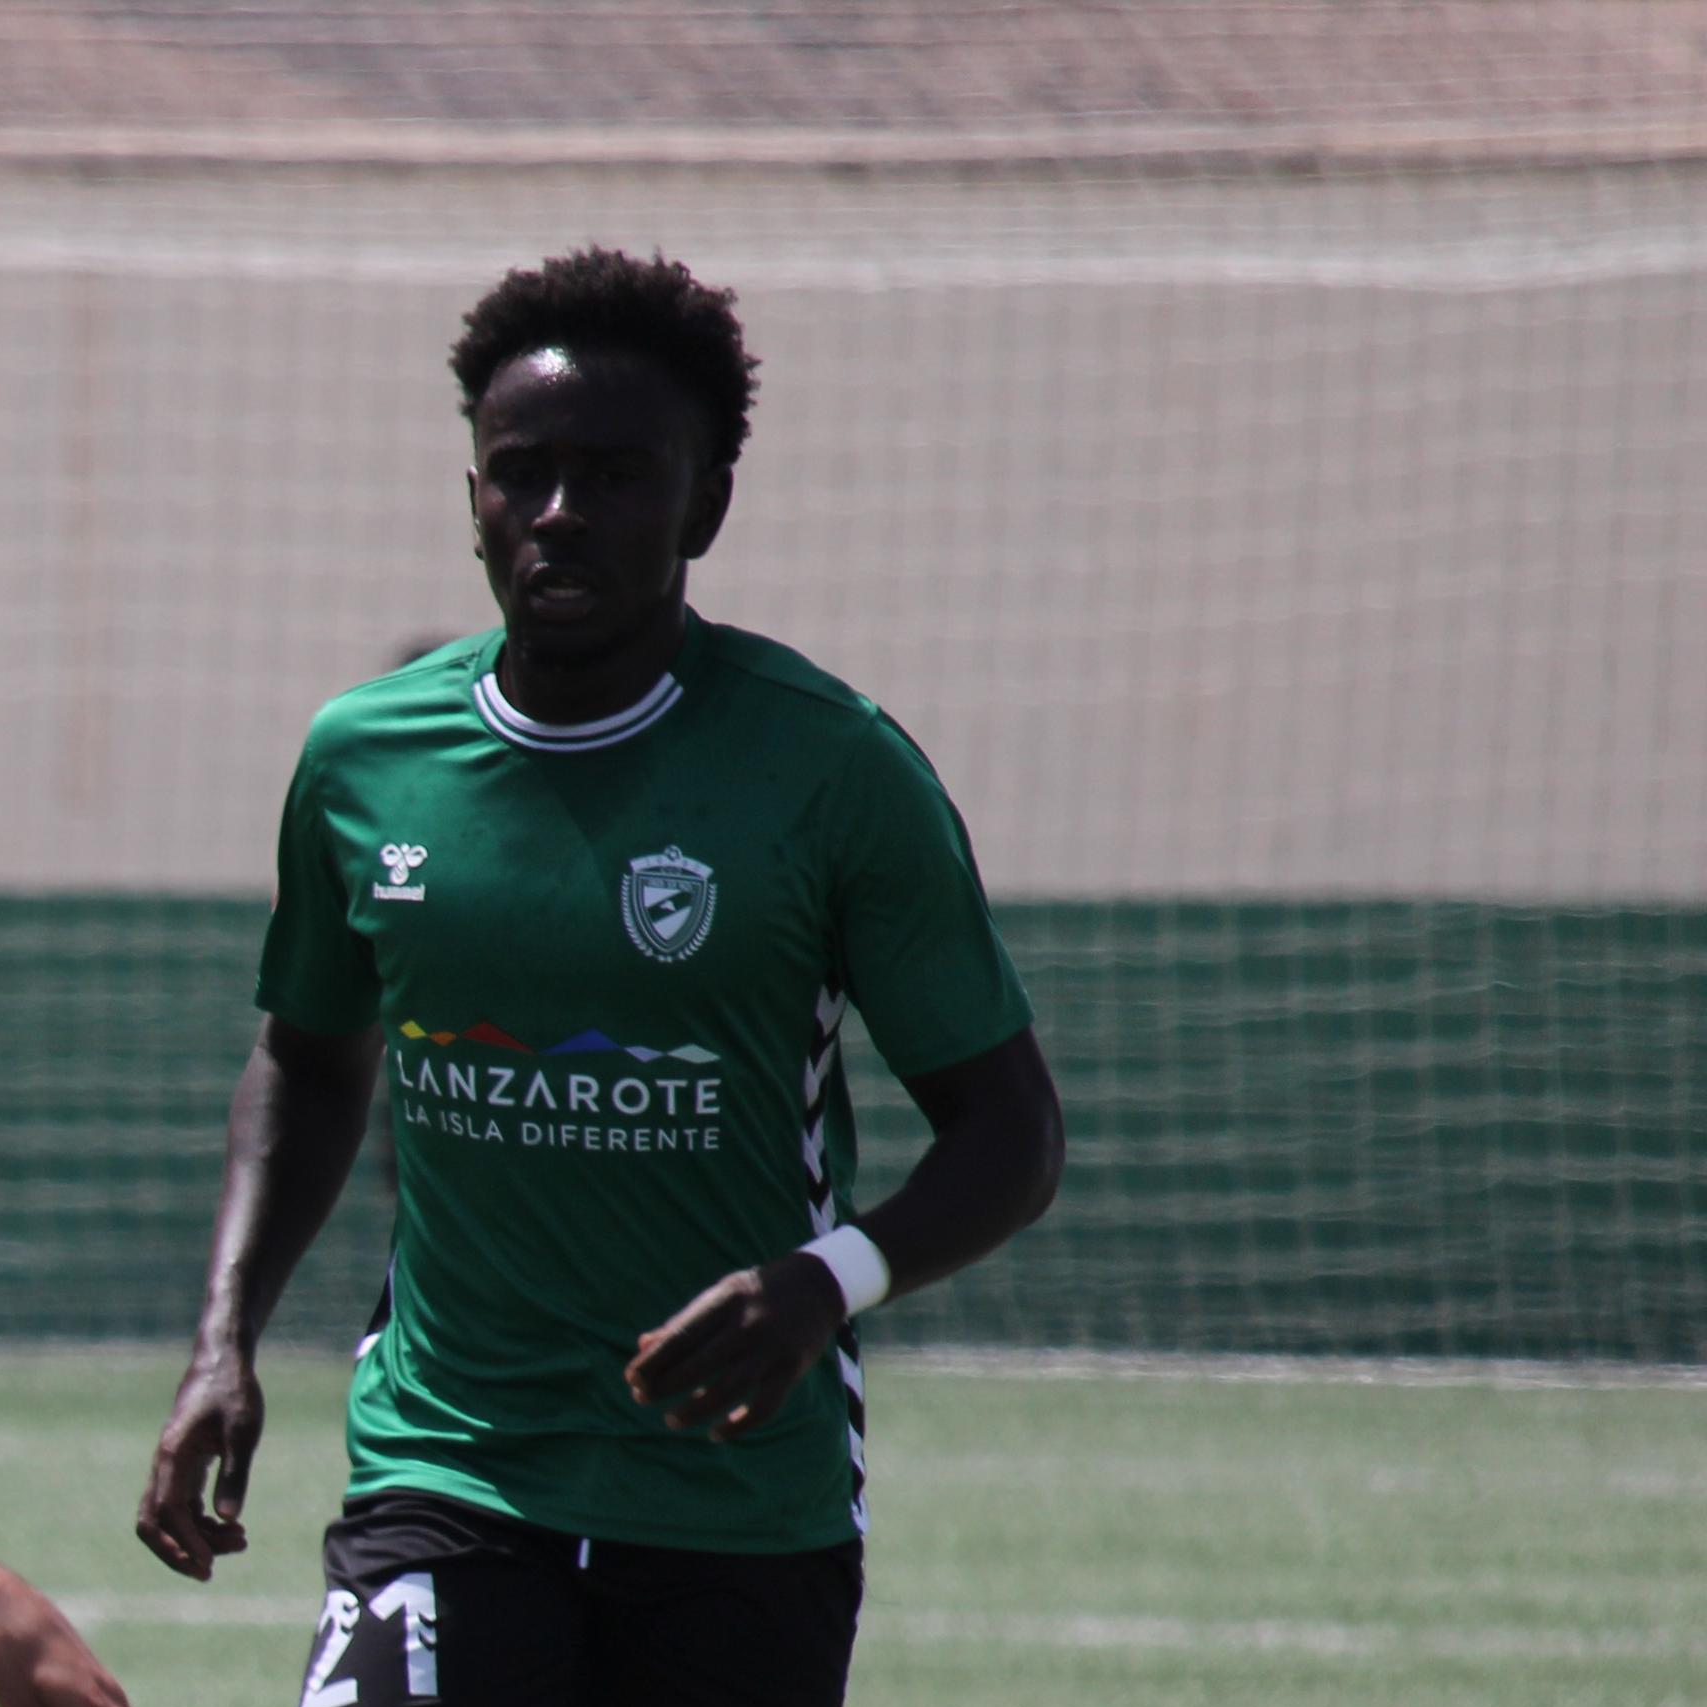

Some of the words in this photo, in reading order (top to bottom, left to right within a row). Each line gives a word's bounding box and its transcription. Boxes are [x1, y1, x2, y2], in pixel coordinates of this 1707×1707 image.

[396, 1049, 722, 1117] LANZAROTE
[404, 1099, 431, 1127] LA
[440, 1111, 505, 1142] ISLA
[522, 1121, 720, 1152] DIFERENTE
